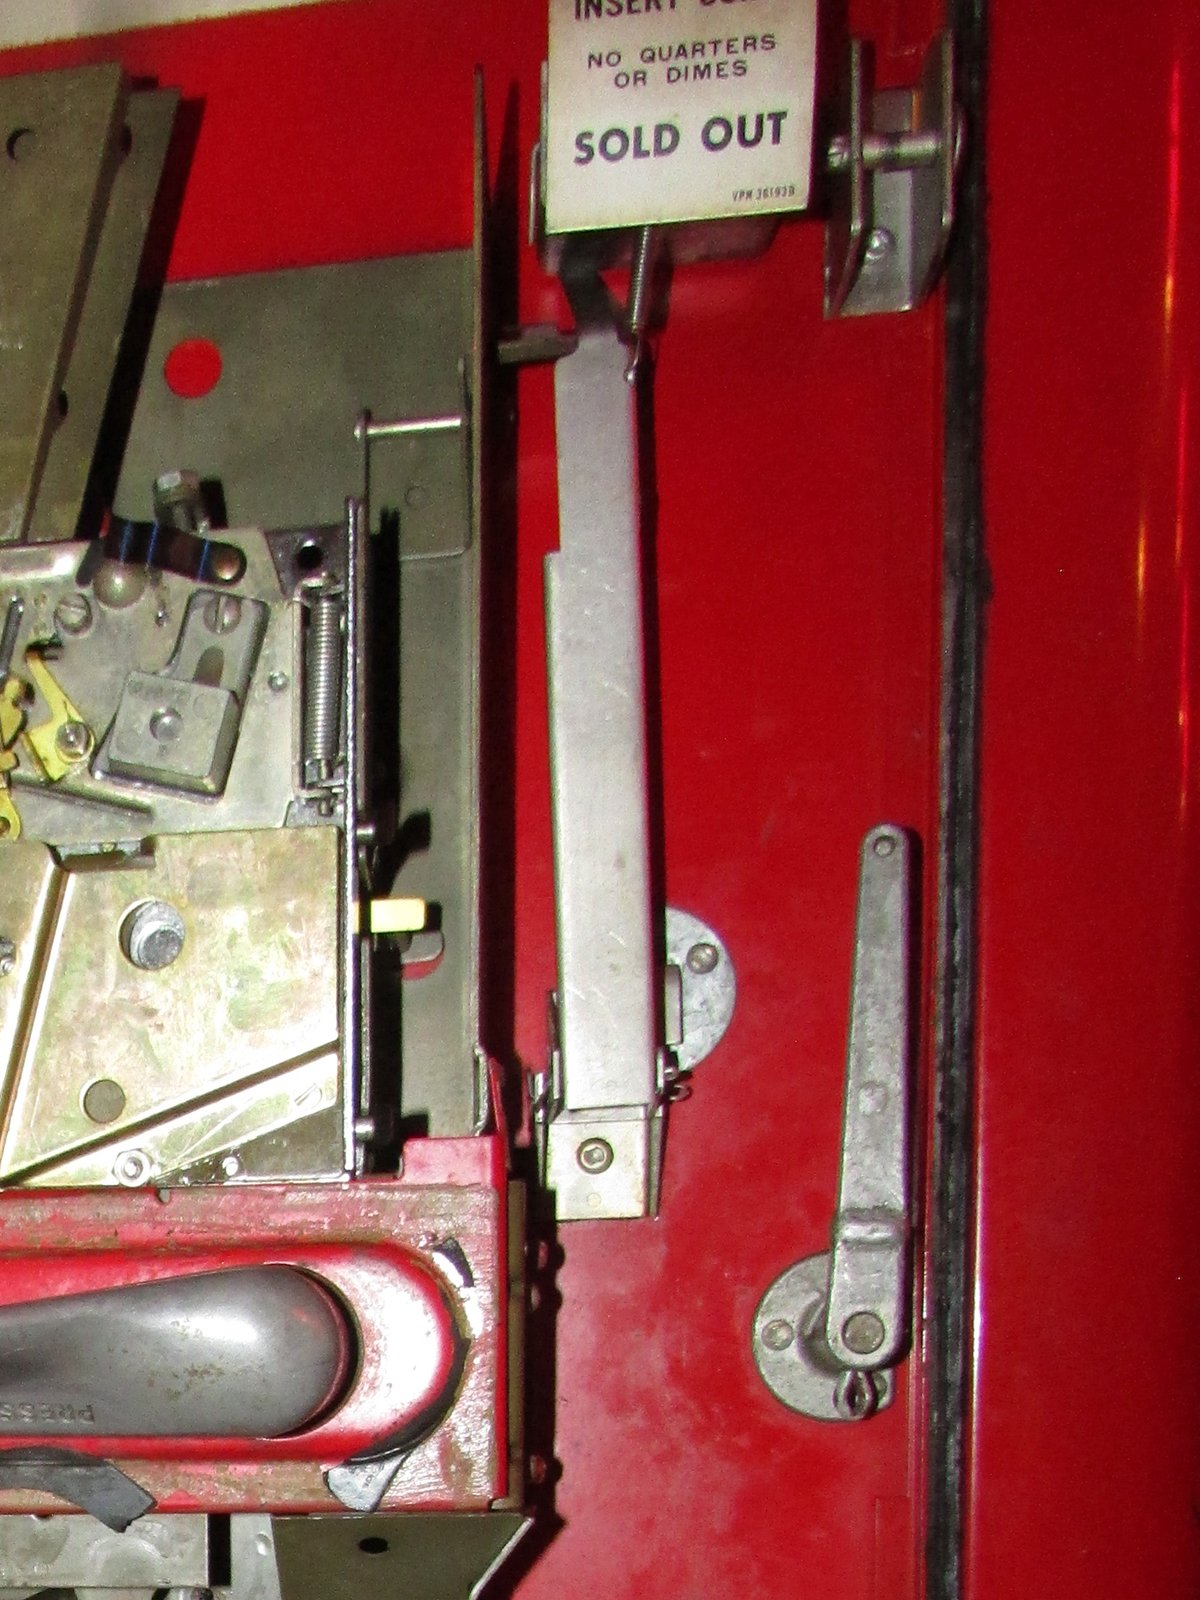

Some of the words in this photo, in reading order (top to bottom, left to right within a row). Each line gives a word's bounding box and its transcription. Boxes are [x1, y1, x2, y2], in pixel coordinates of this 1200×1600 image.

[587, 51, 621, 69] NO
[640, 34, 777, 64] QUARTERS
[614, 69, 647, 89] OR
[667, 60, 748, 84] DIMES
[573, 123, 680, 166] SOLD
[701, 111, 788, 152] OUT
